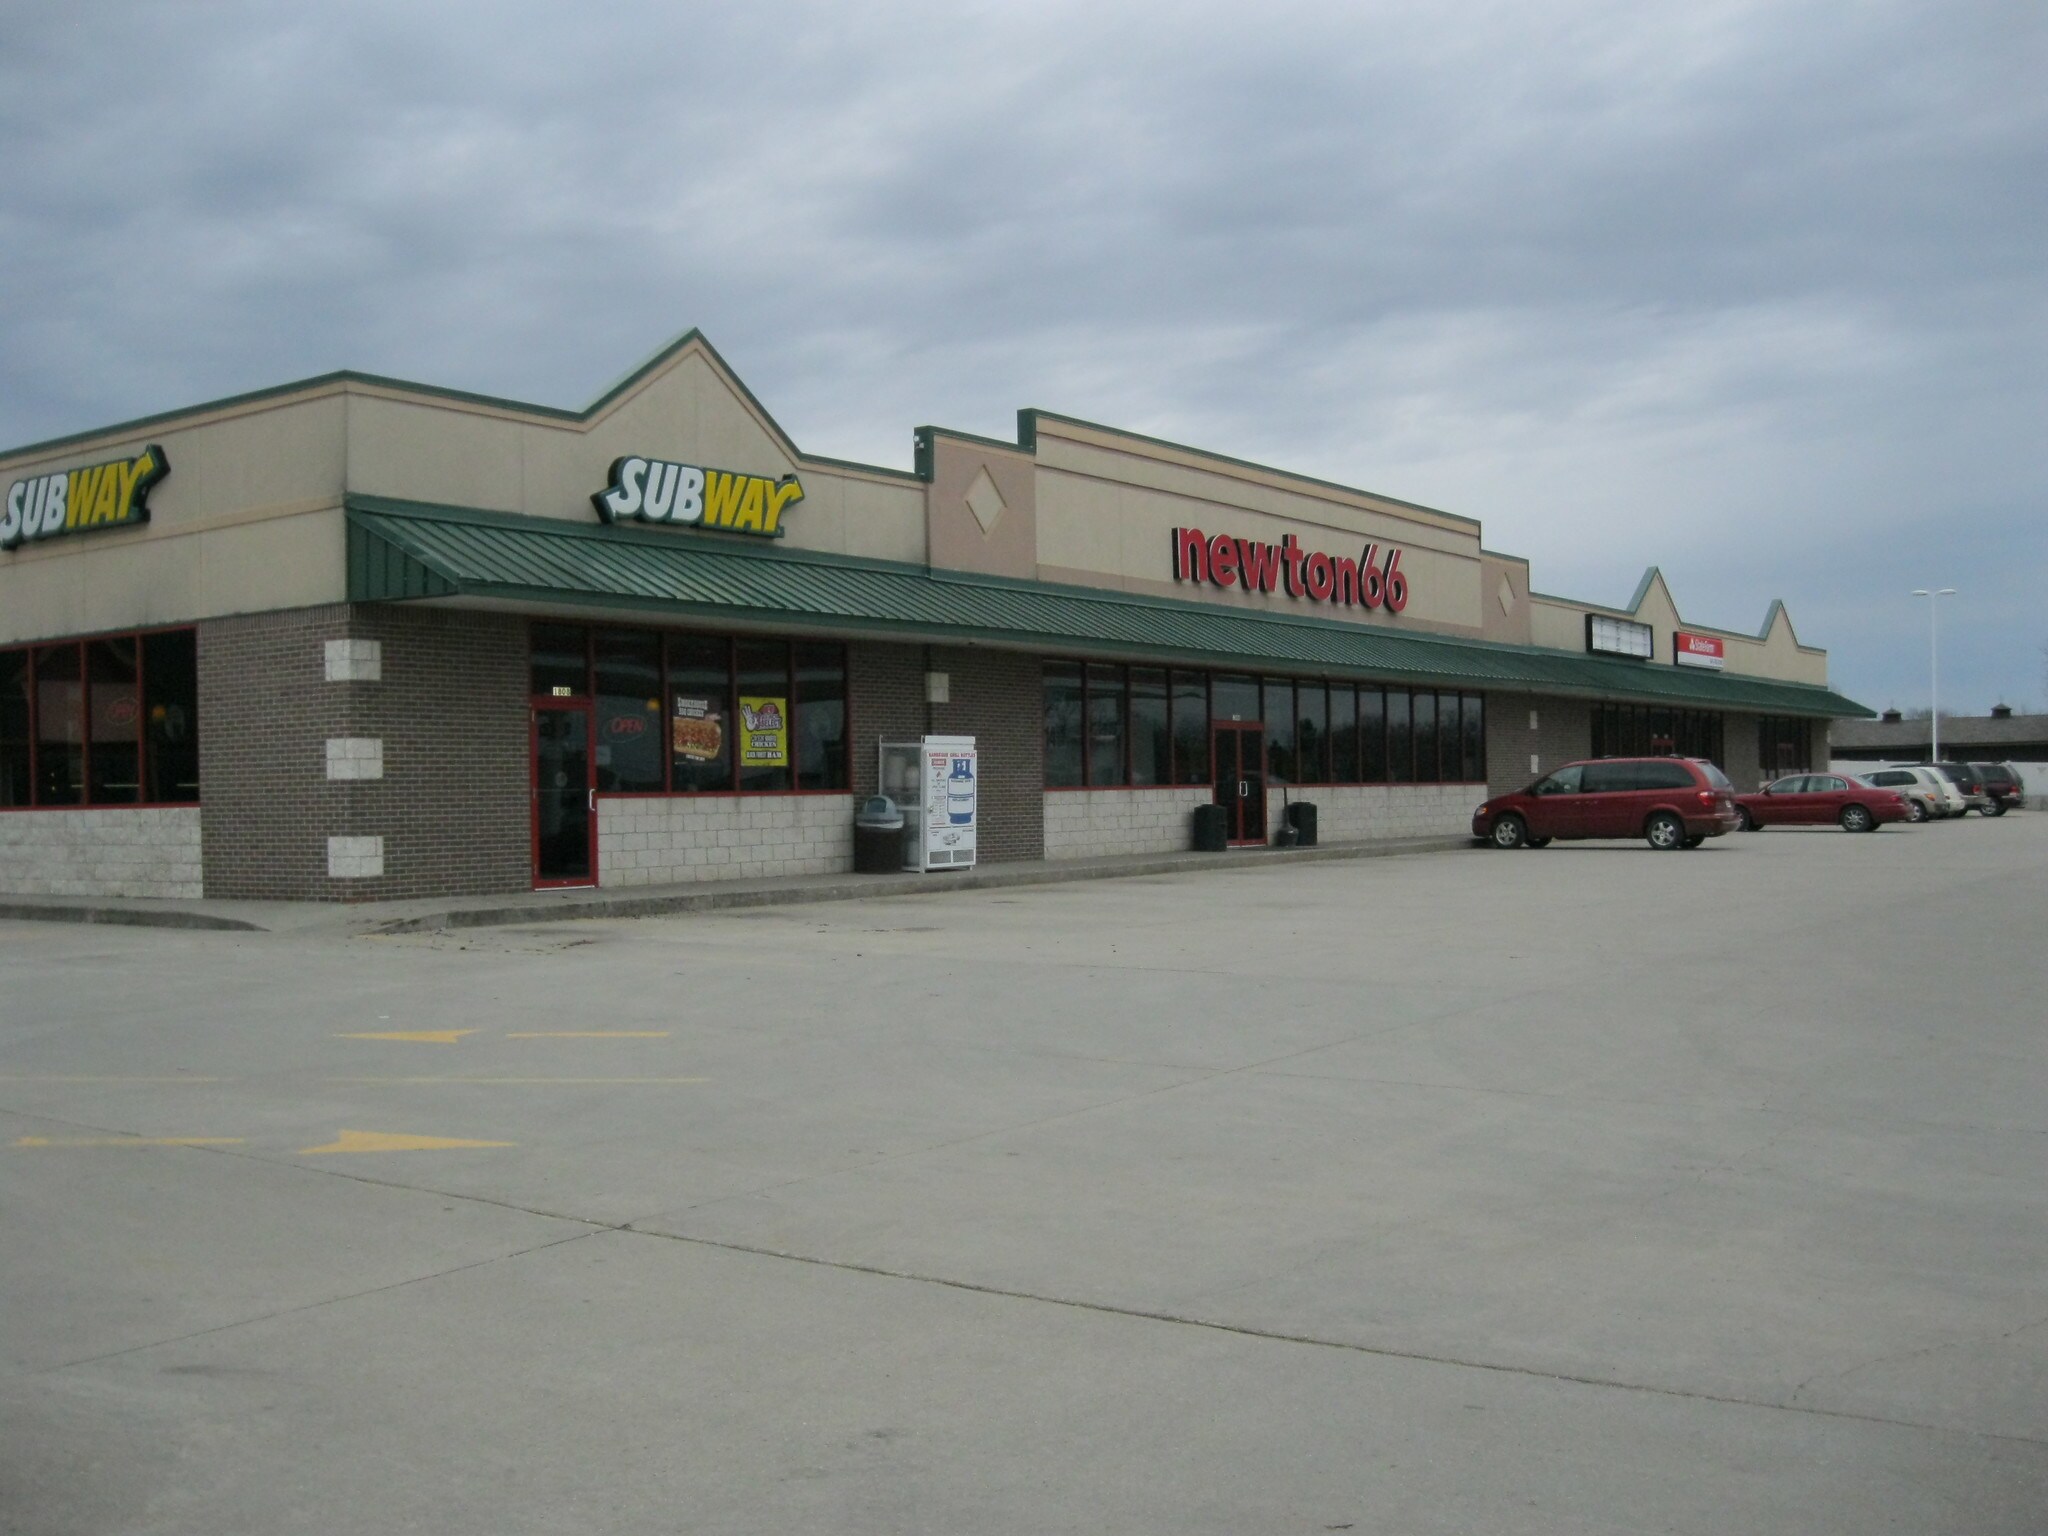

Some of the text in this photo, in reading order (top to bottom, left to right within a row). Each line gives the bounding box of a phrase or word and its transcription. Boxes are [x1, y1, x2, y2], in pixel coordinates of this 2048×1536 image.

[0, 453, 154, 541] SUBWAY
[606, 458, 803, 533] SUBWAY
[1171, 527, 1409, 613] newton66
[611, 718, 645, 734] OPEN
